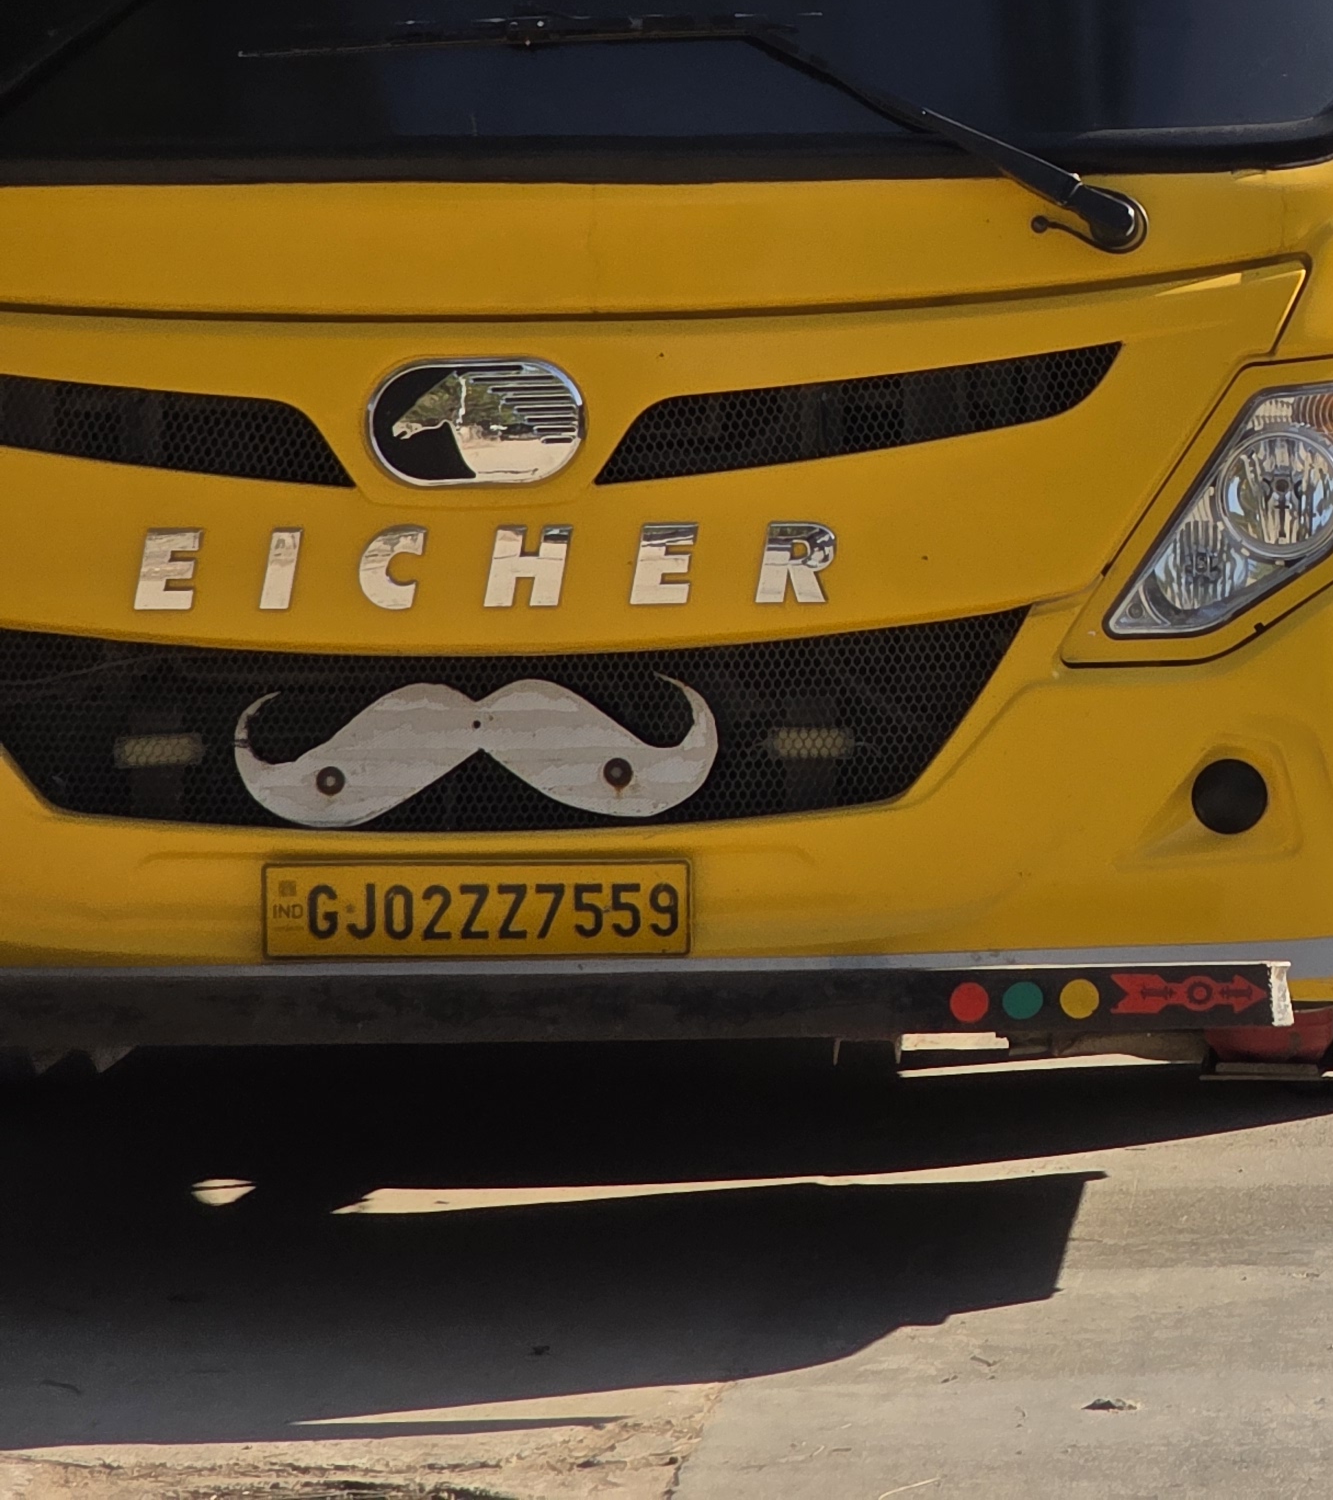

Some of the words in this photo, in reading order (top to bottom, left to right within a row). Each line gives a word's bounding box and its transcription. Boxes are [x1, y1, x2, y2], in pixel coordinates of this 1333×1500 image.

[133, 520, 840, 611] EICHER
[272, 903, 305, 920] IND
[306, 883, 679, 941] GJ02ZZ7559
